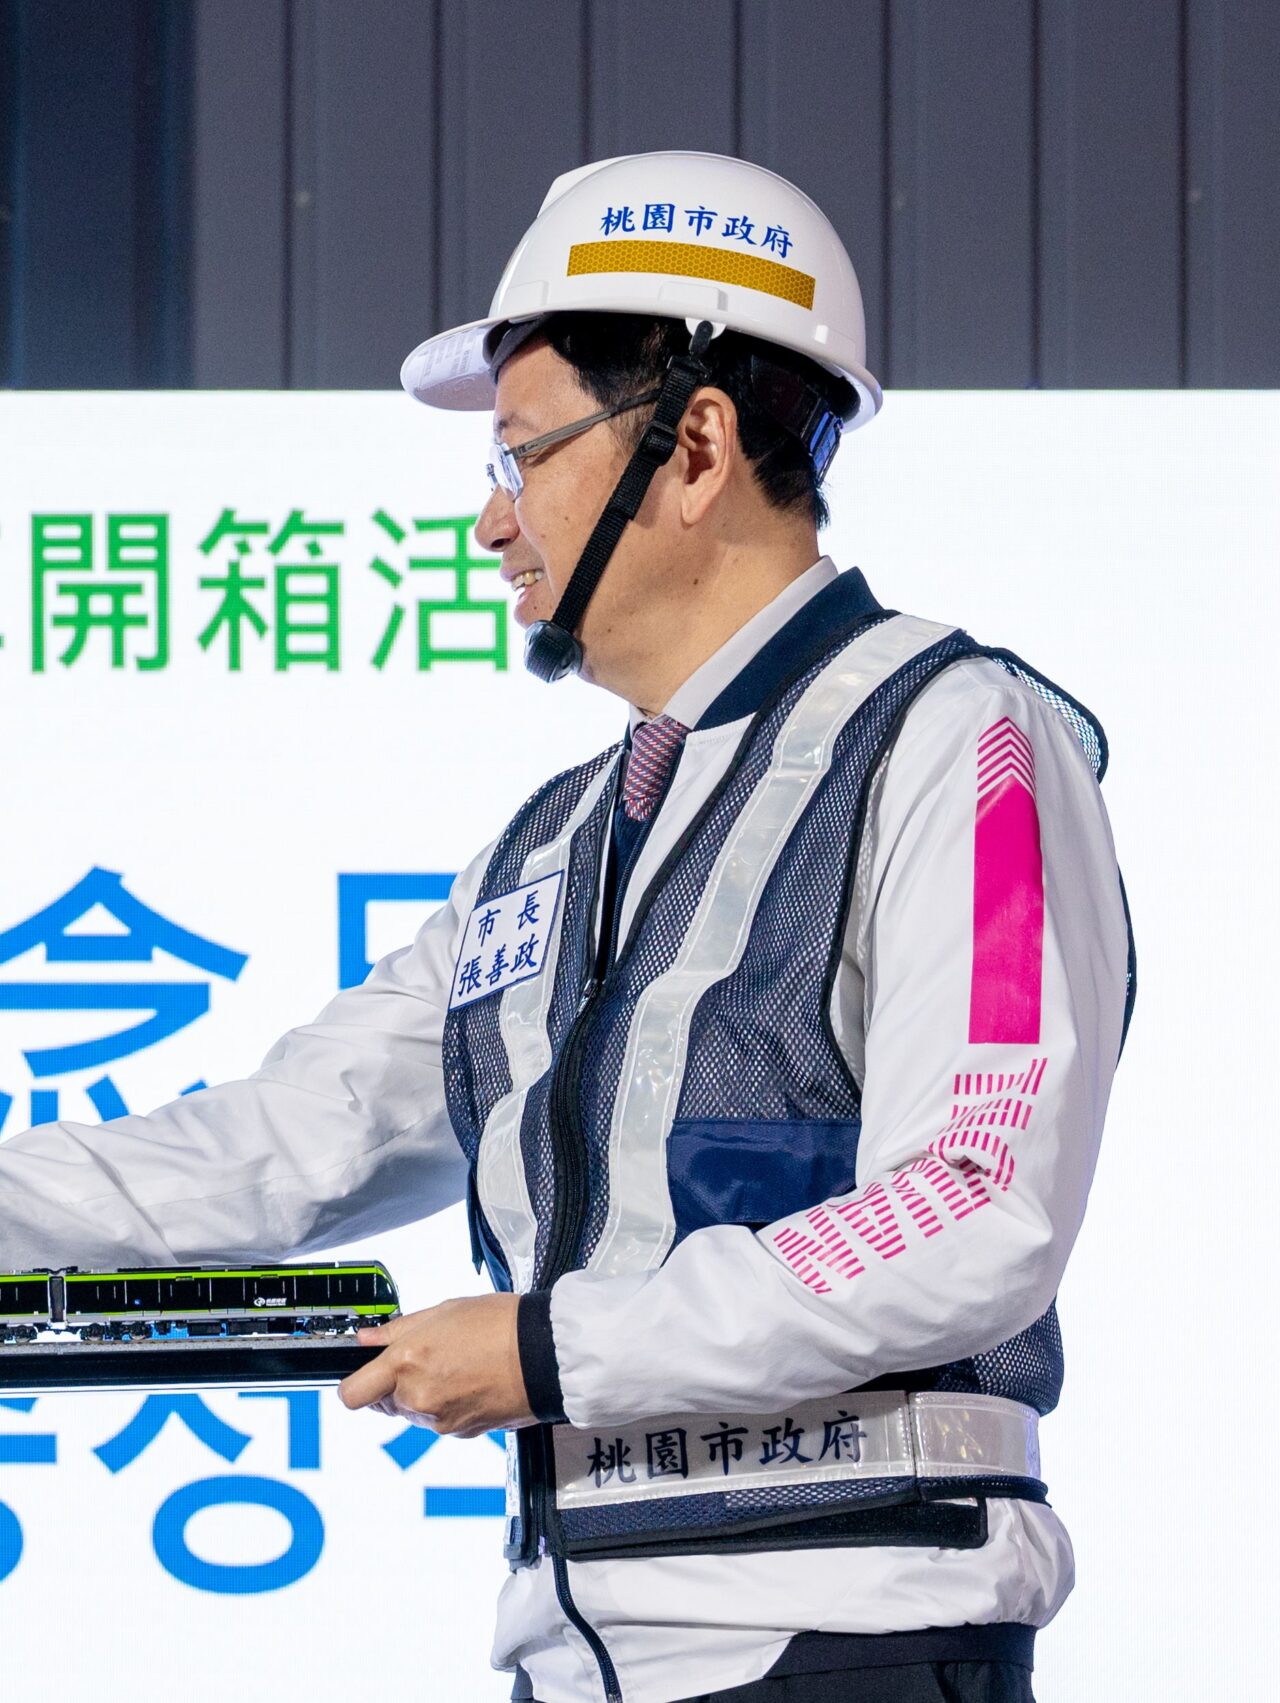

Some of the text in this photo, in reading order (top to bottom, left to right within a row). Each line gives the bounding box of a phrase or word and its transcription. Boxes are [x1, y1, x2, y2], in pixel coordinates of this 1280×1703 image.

[600, 203, 794, 259] 桃園市政府
[477, 889, 540, 947] 市長
[458, 934, 539, 998] 張善政
[586, 1409, 868, 1489] 桃園市政府
